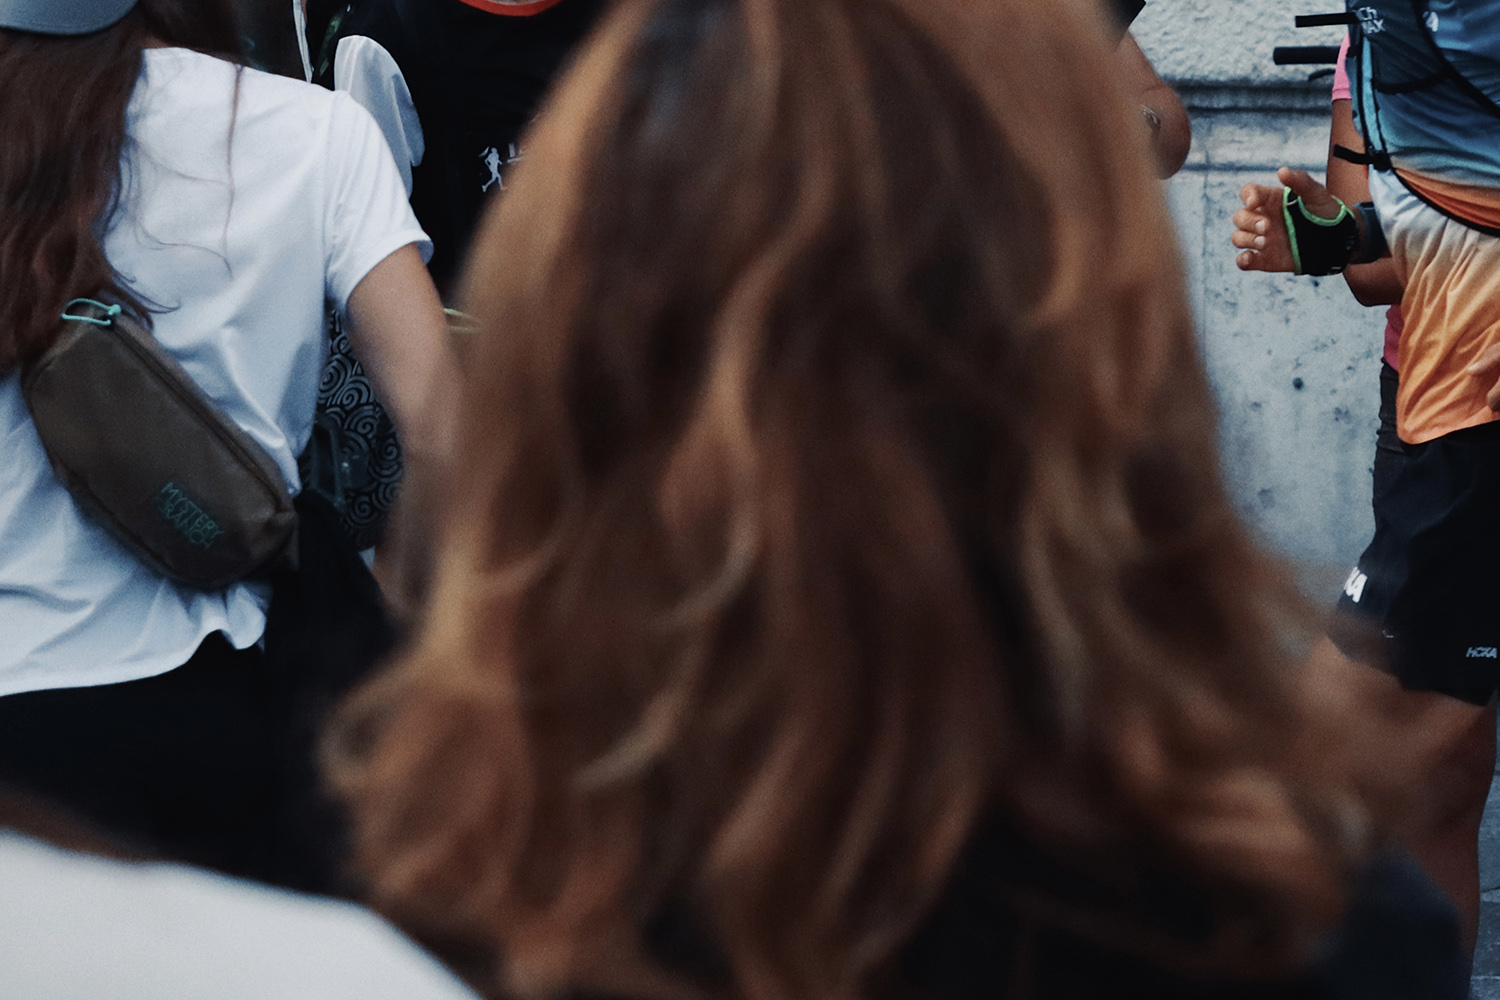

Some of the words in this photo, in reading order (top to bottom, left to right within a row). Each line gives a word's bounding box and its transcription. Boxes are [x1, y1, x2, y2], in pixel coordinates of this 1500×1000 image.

[160, 482, 225, 539] MYSTERY
[161, 502, 214, 550] RANCH
[1465, 646, 1498, 659] HOKA
